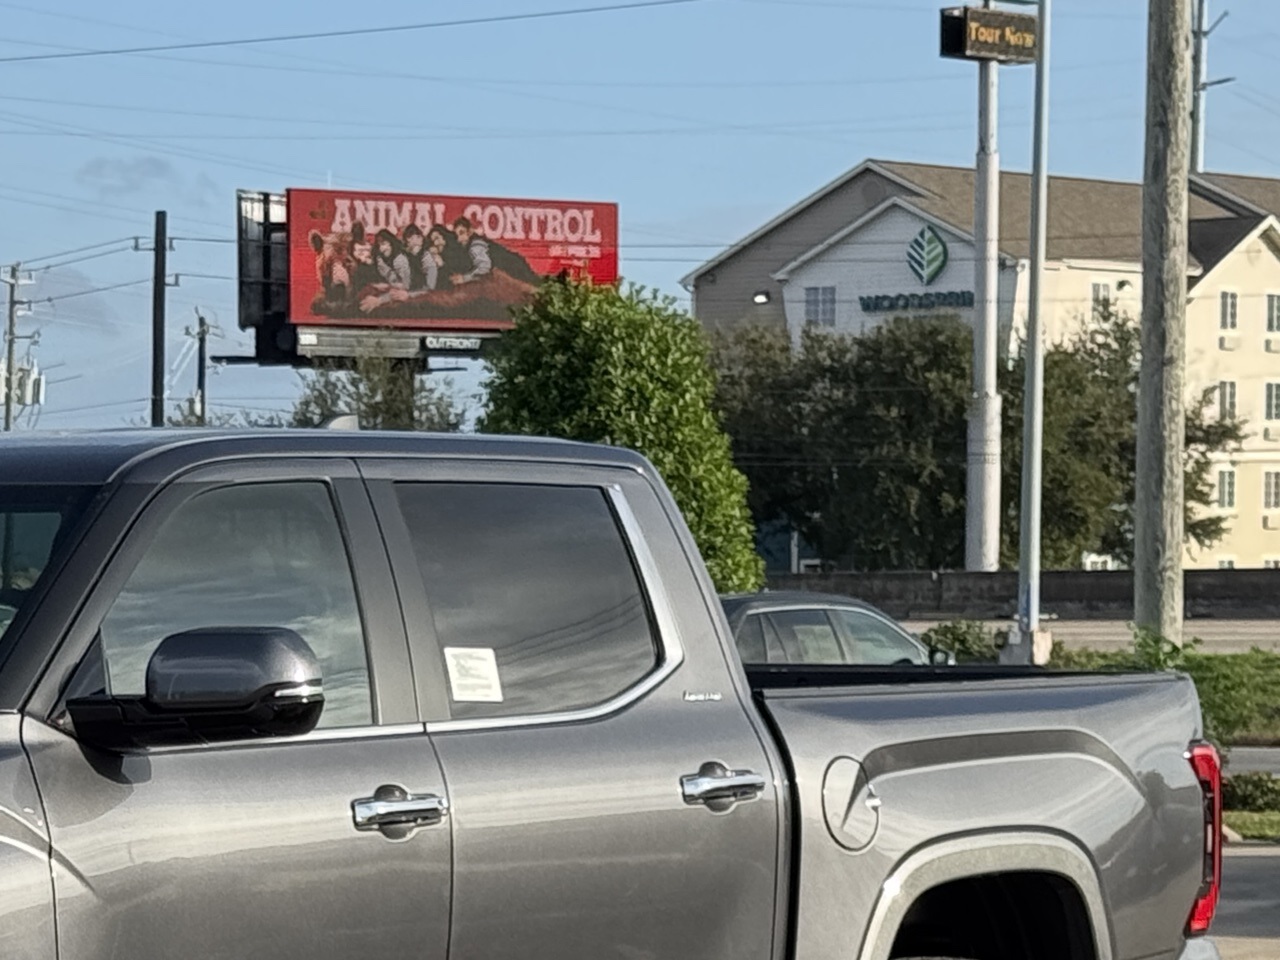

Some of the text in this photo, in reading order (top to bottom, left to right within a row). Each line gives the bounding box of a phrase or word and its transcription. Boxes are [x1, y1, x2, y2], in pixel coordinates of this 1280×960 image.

[969, 22, 1001, 44] Tour
[331, 199, 602, 243] ANIMAL CONTROL
